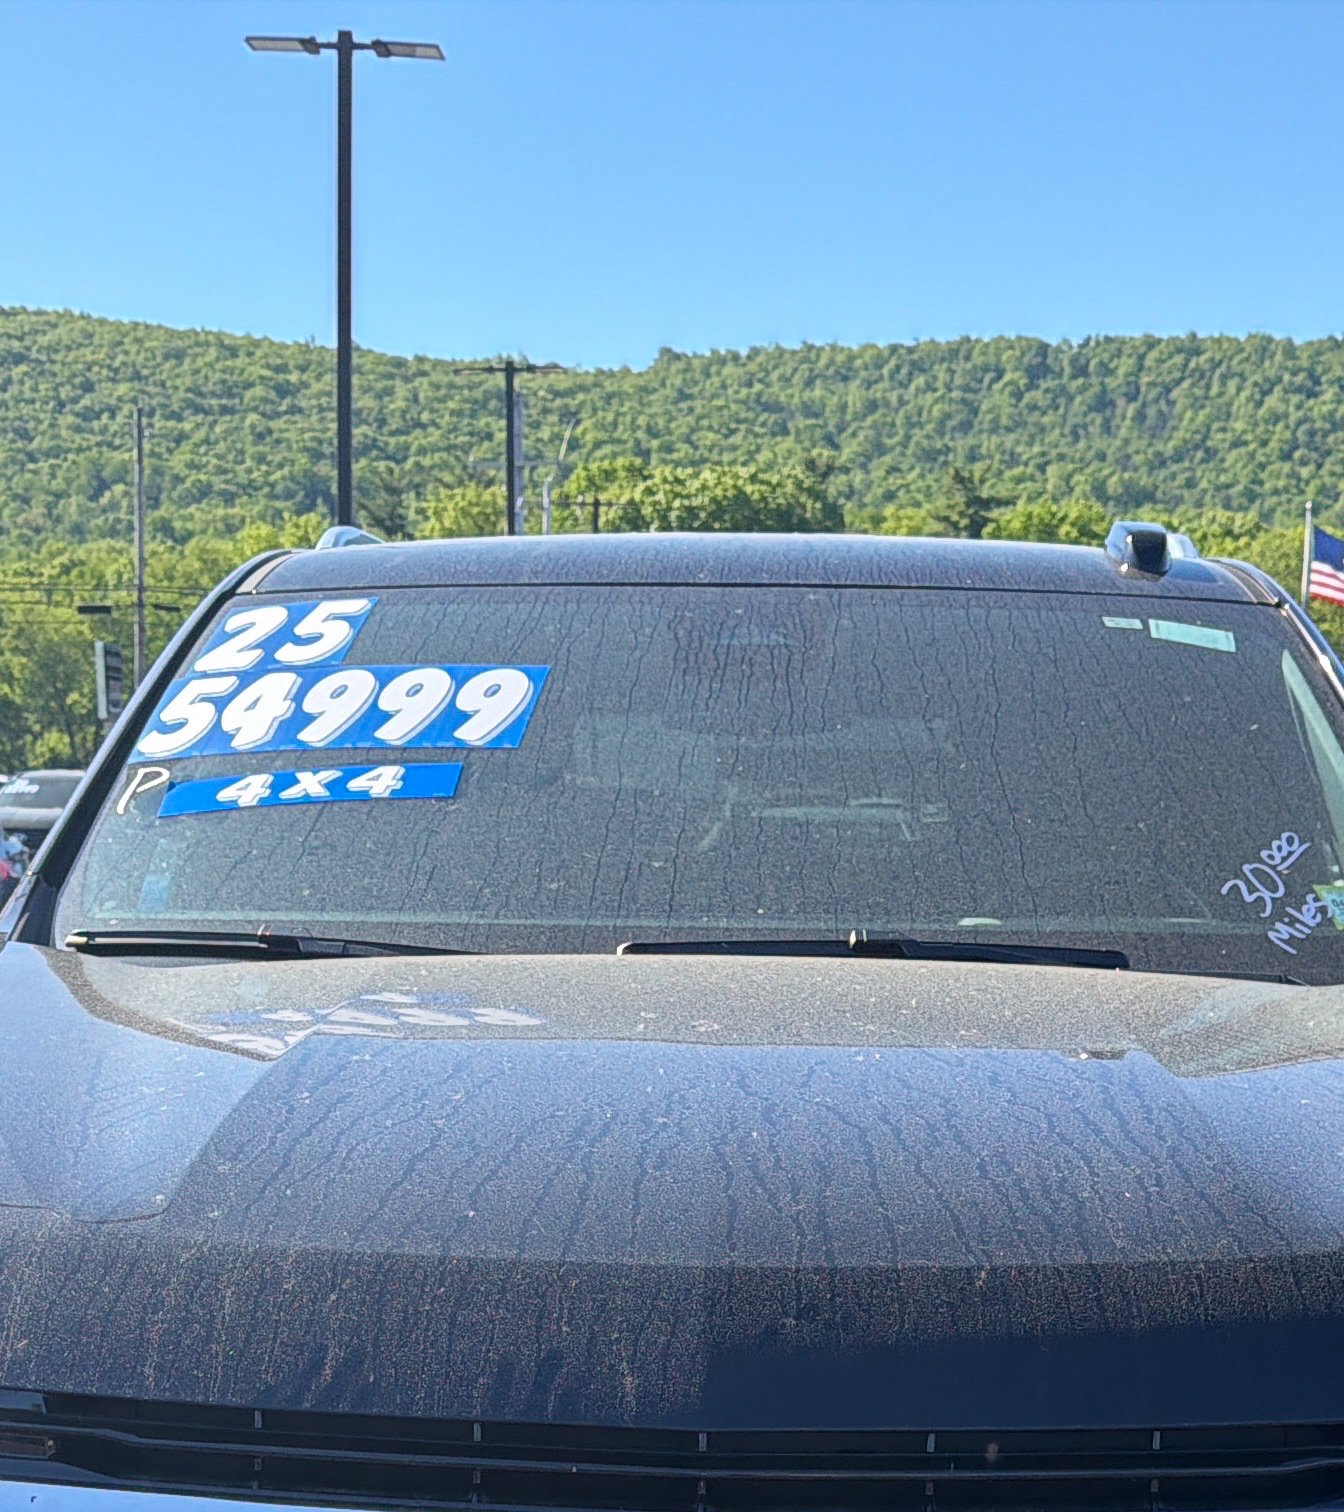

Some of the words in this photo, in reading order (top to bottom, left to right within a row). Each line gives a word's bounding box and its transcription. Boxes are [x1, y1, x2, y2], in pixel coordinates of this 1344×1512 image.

[193, 598, 372, 673] 25
[137, 667, 534, 758] 54999
[116, 767, 170, 815] P
[1267, 893, 1332, 954] Miles
